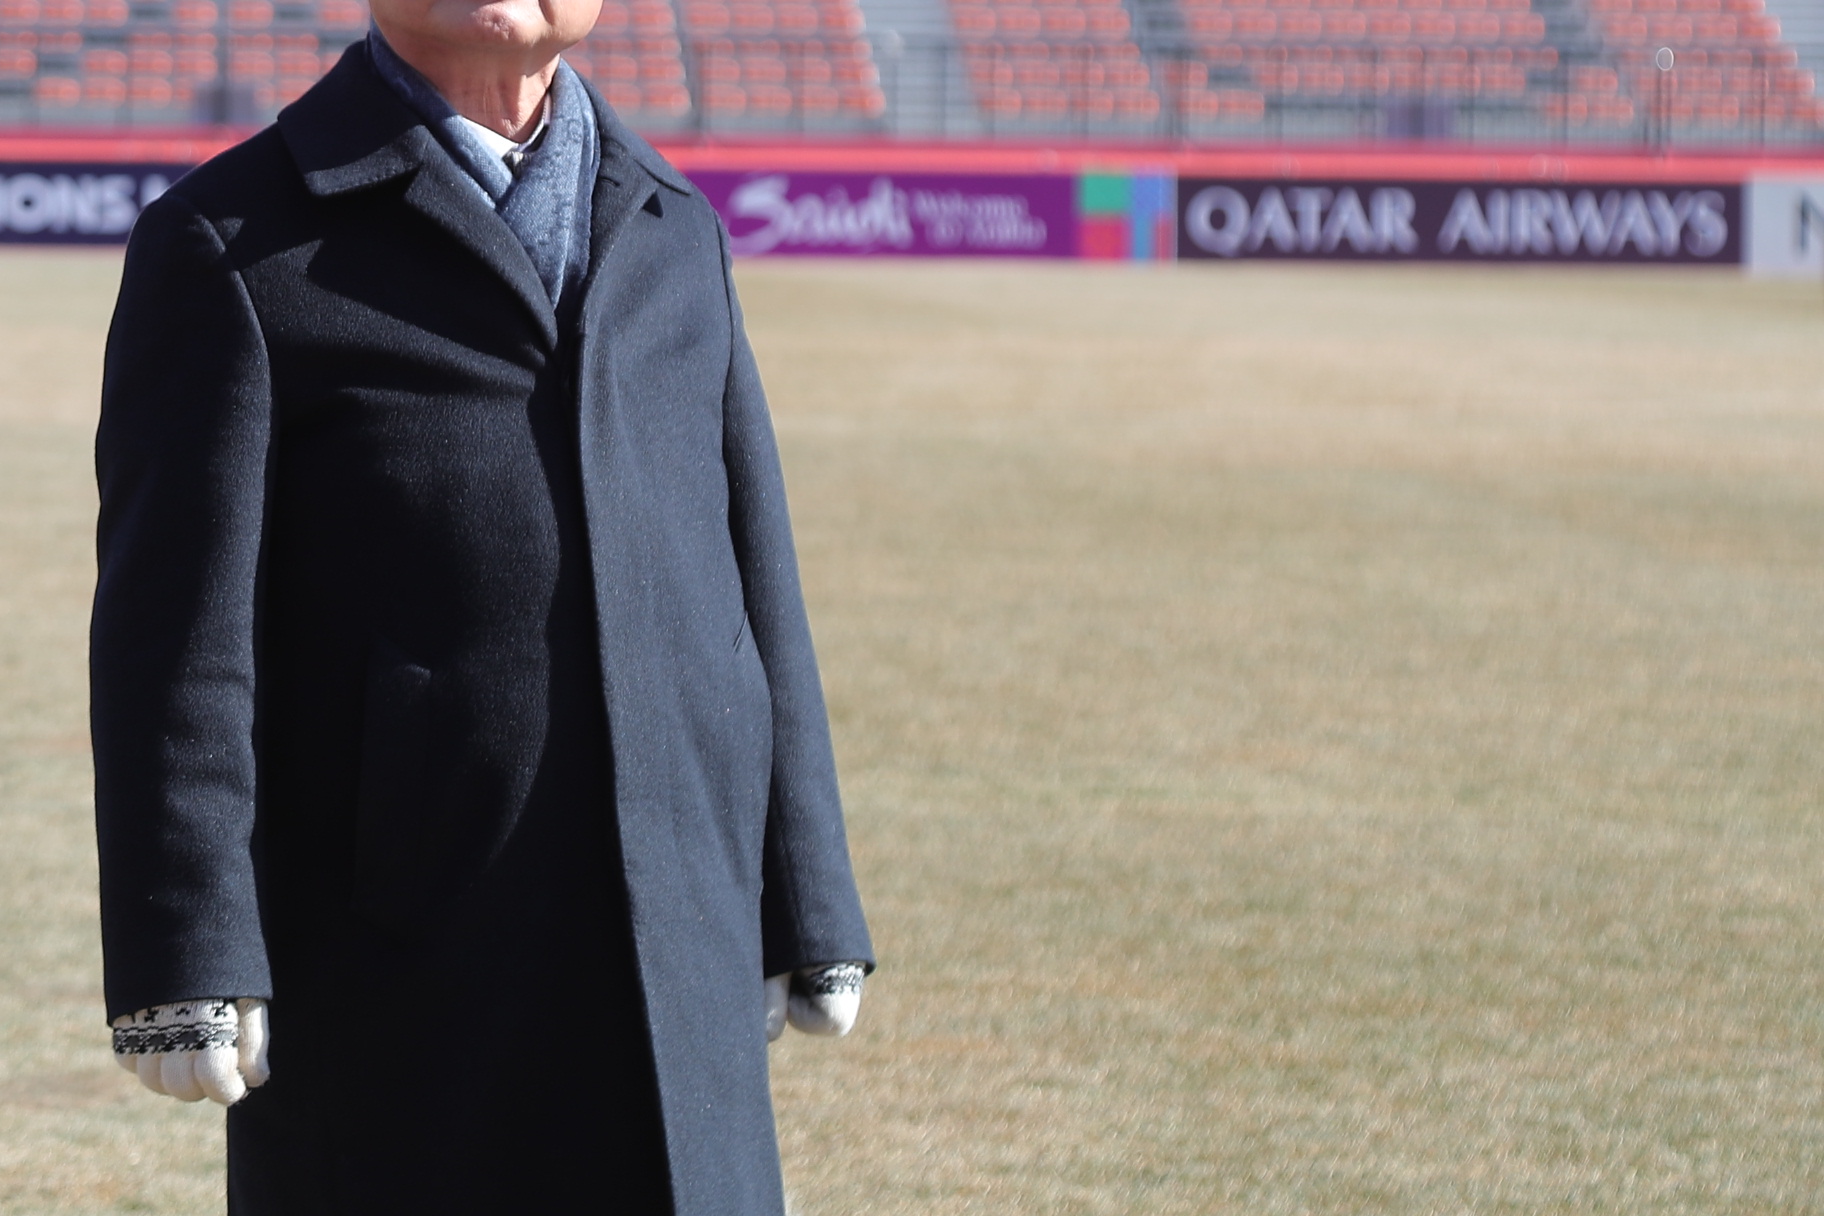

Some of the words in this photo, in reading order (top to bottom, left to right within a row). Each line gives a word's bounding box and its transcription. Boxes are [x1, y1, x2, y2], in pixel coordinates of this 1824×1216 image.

[729, 172, 913, 255] Saudi
[1185, 187, 1419, 257] QATAR
[1438, 188, 1728, 257] AIRWAYS
